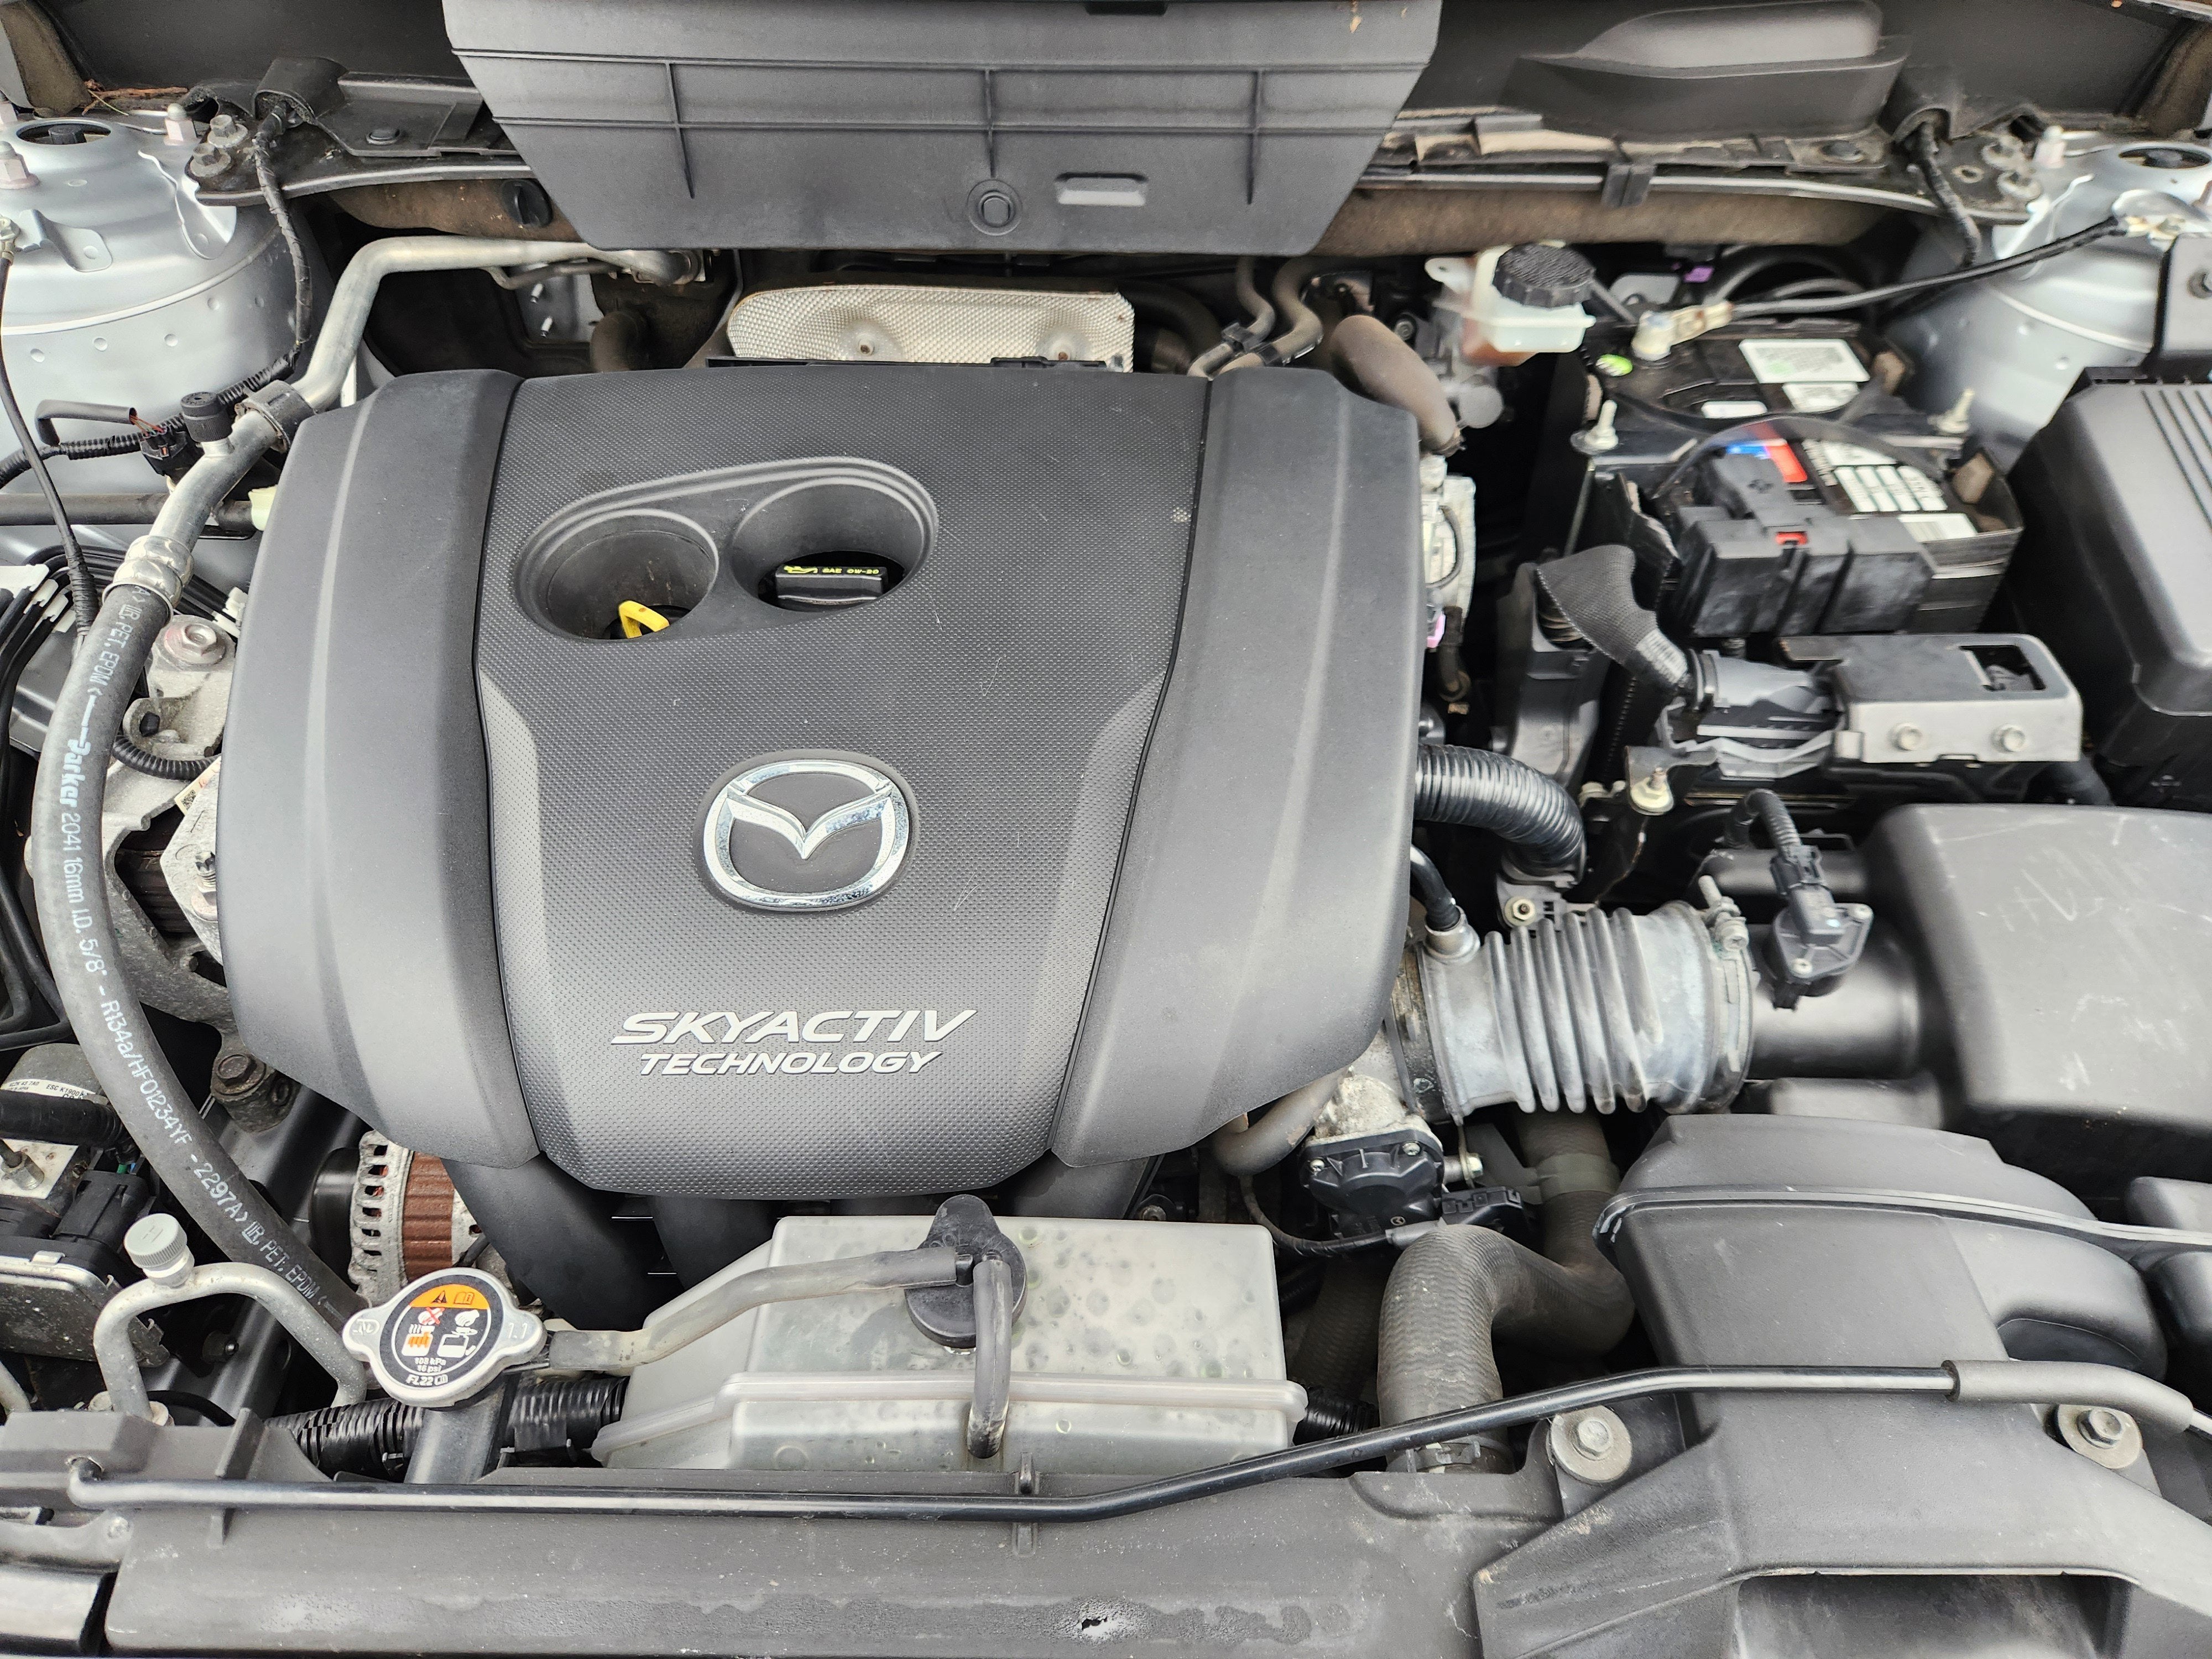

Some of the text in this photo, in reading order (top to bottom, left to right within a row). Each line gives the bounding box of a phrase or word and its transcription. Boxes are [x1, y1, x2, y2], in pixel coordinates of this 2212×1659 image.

[88, 650, 120, 686] EPDM
[60, 739, 92, 808] Parker
[61, 812, 82, 851] 2041
[63, 857, 85, 904] 16mm
[611, 1009, 977, 1045] SKYACTIV
[640, 1051, 943, 1076] TECHNOLOGY
[285, 1264, 321, 1299] EPDM
[406, 1374, 434, 1386] FL22
[427, 1365, 442, 1373] psi
